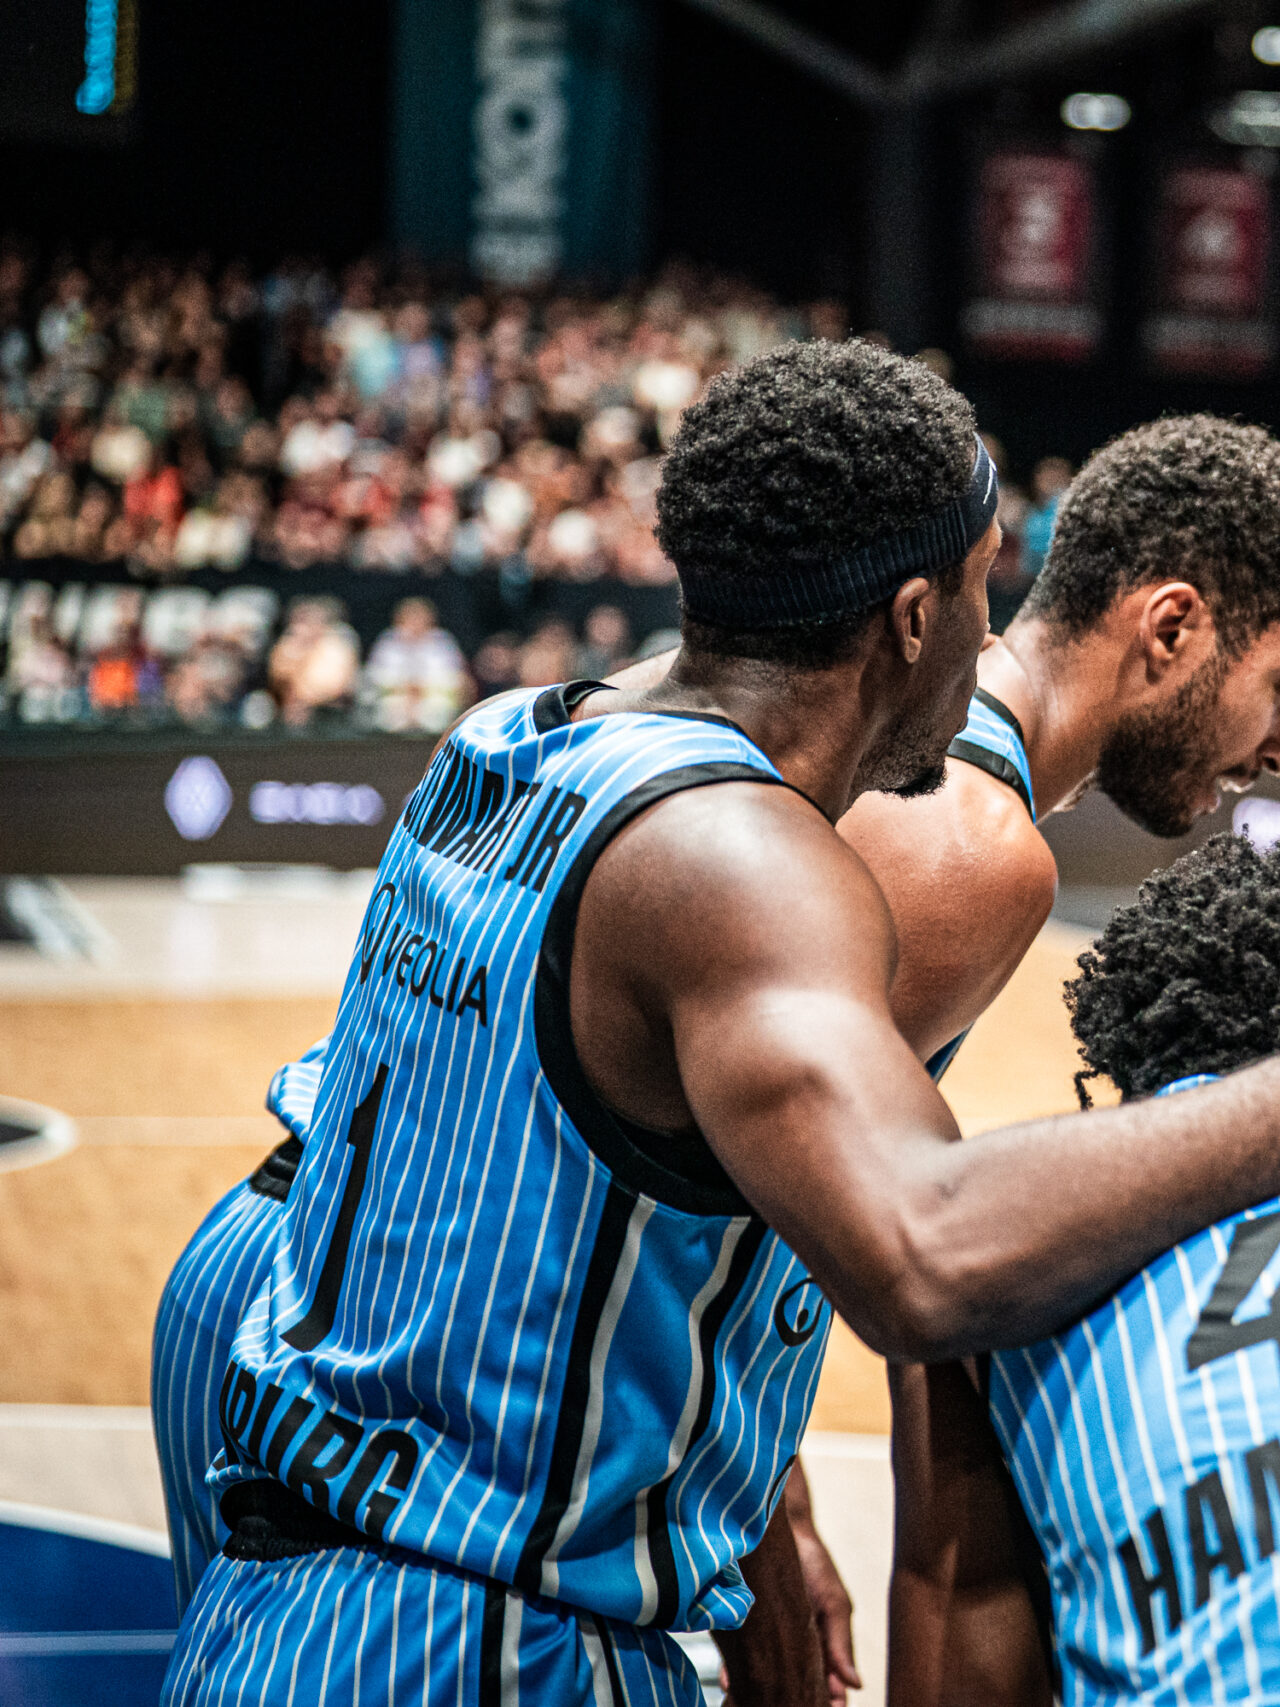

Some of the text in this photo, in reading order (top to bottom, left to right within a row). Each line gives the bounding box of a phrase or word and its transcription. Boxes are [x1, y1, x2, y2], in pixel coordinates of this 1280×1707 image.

[504, 786, 588, 890] JR
[382, 922, 487, 1028] VEOLIA
[279, 1061, 390, 1353] 1
